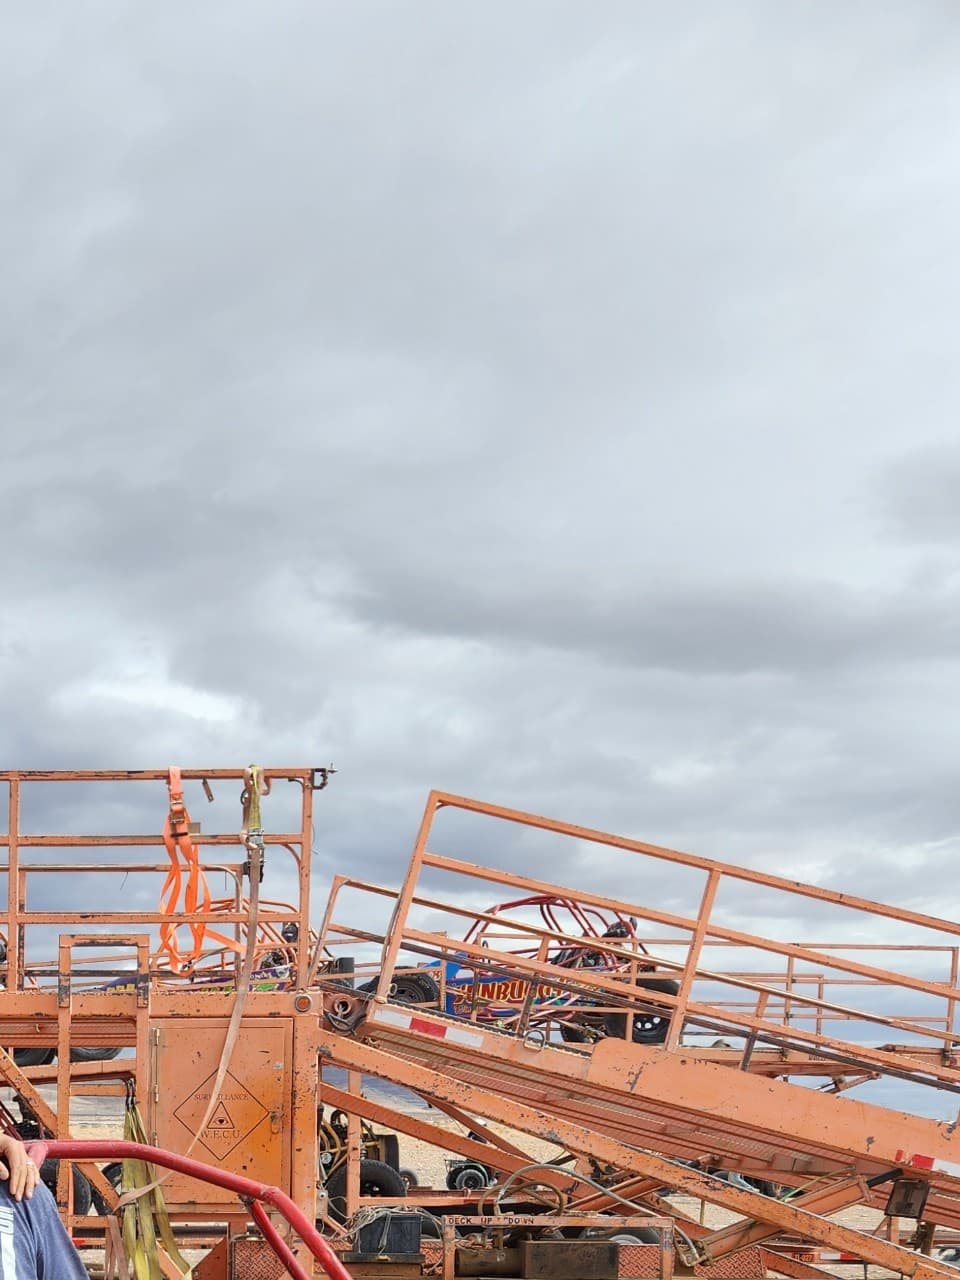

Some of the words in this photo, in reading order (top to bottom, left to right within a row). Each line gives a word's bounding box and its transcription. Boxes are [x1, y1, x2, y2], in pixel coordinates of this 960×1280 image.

[448, 1217, 472, 1225] DECK
[480, 1217, 493, 1225] UP
[508, 1217, 534, 1225] DOWN
